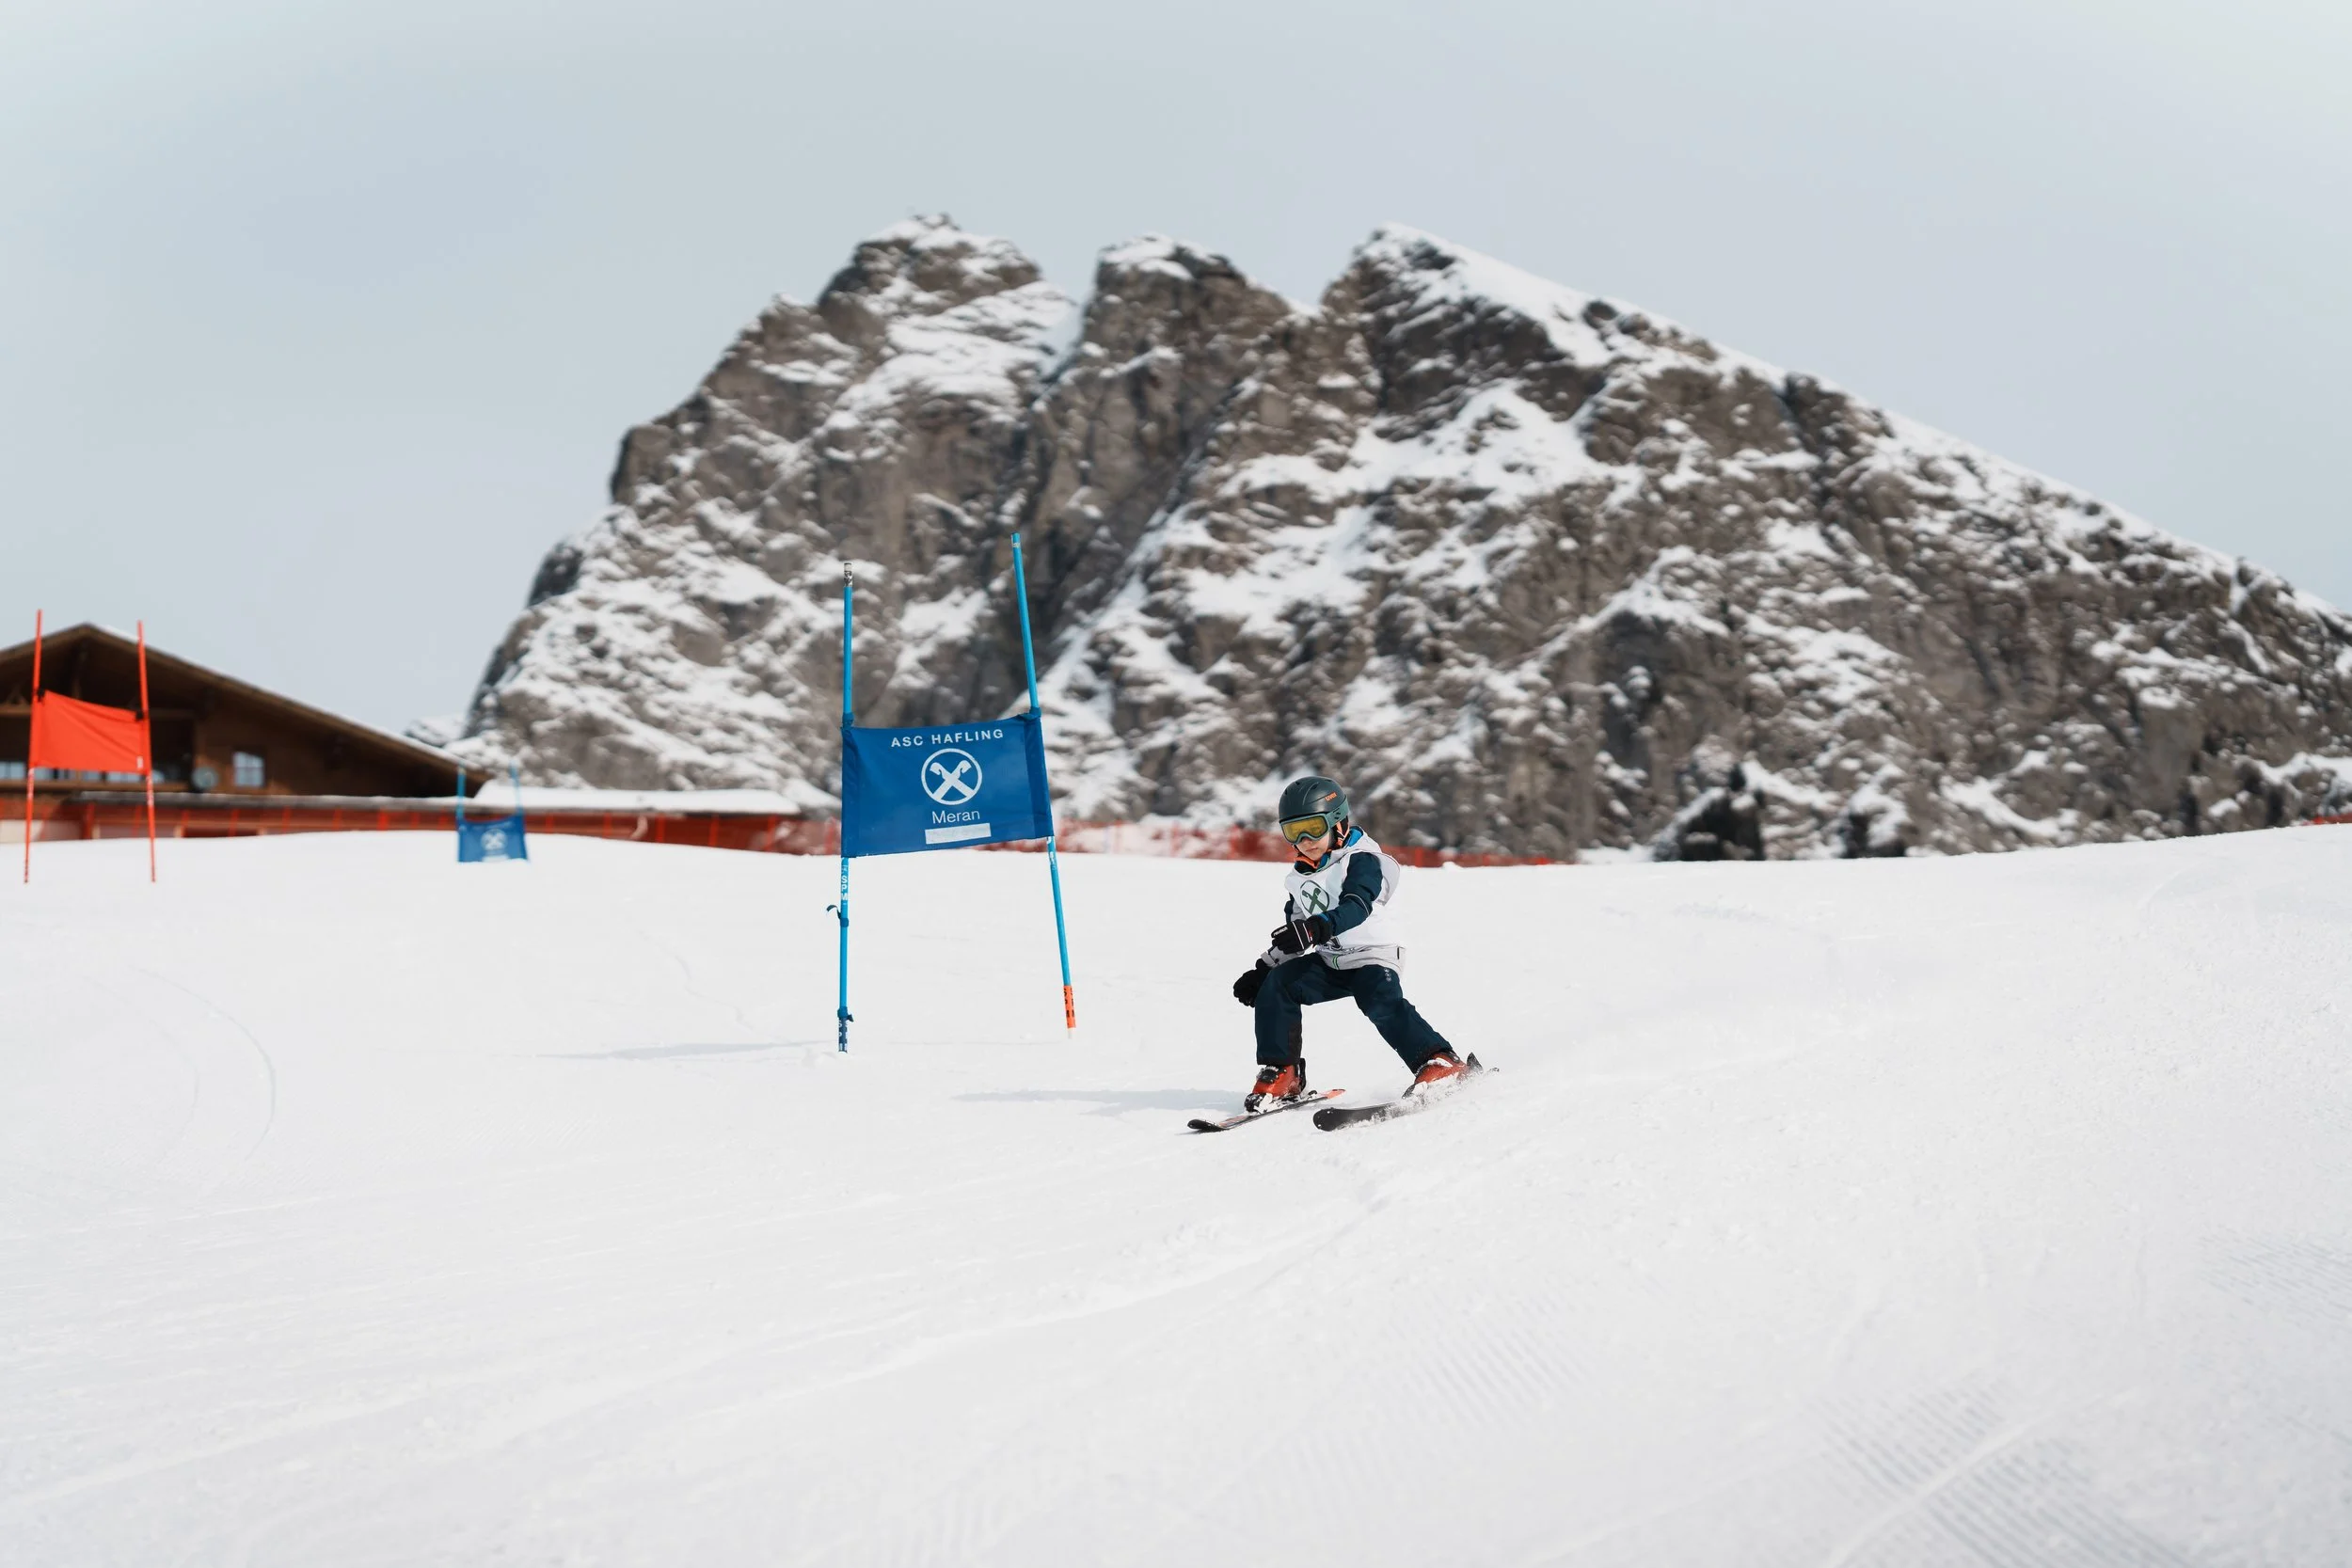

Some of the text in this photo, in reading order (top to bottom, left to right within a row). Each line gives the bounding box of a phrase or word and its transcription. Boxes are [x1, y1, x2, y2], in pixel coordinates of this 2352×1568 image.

[891, 729, 1004, 748] ASC HAFLING
[931, 810, 980, 824] Meran
